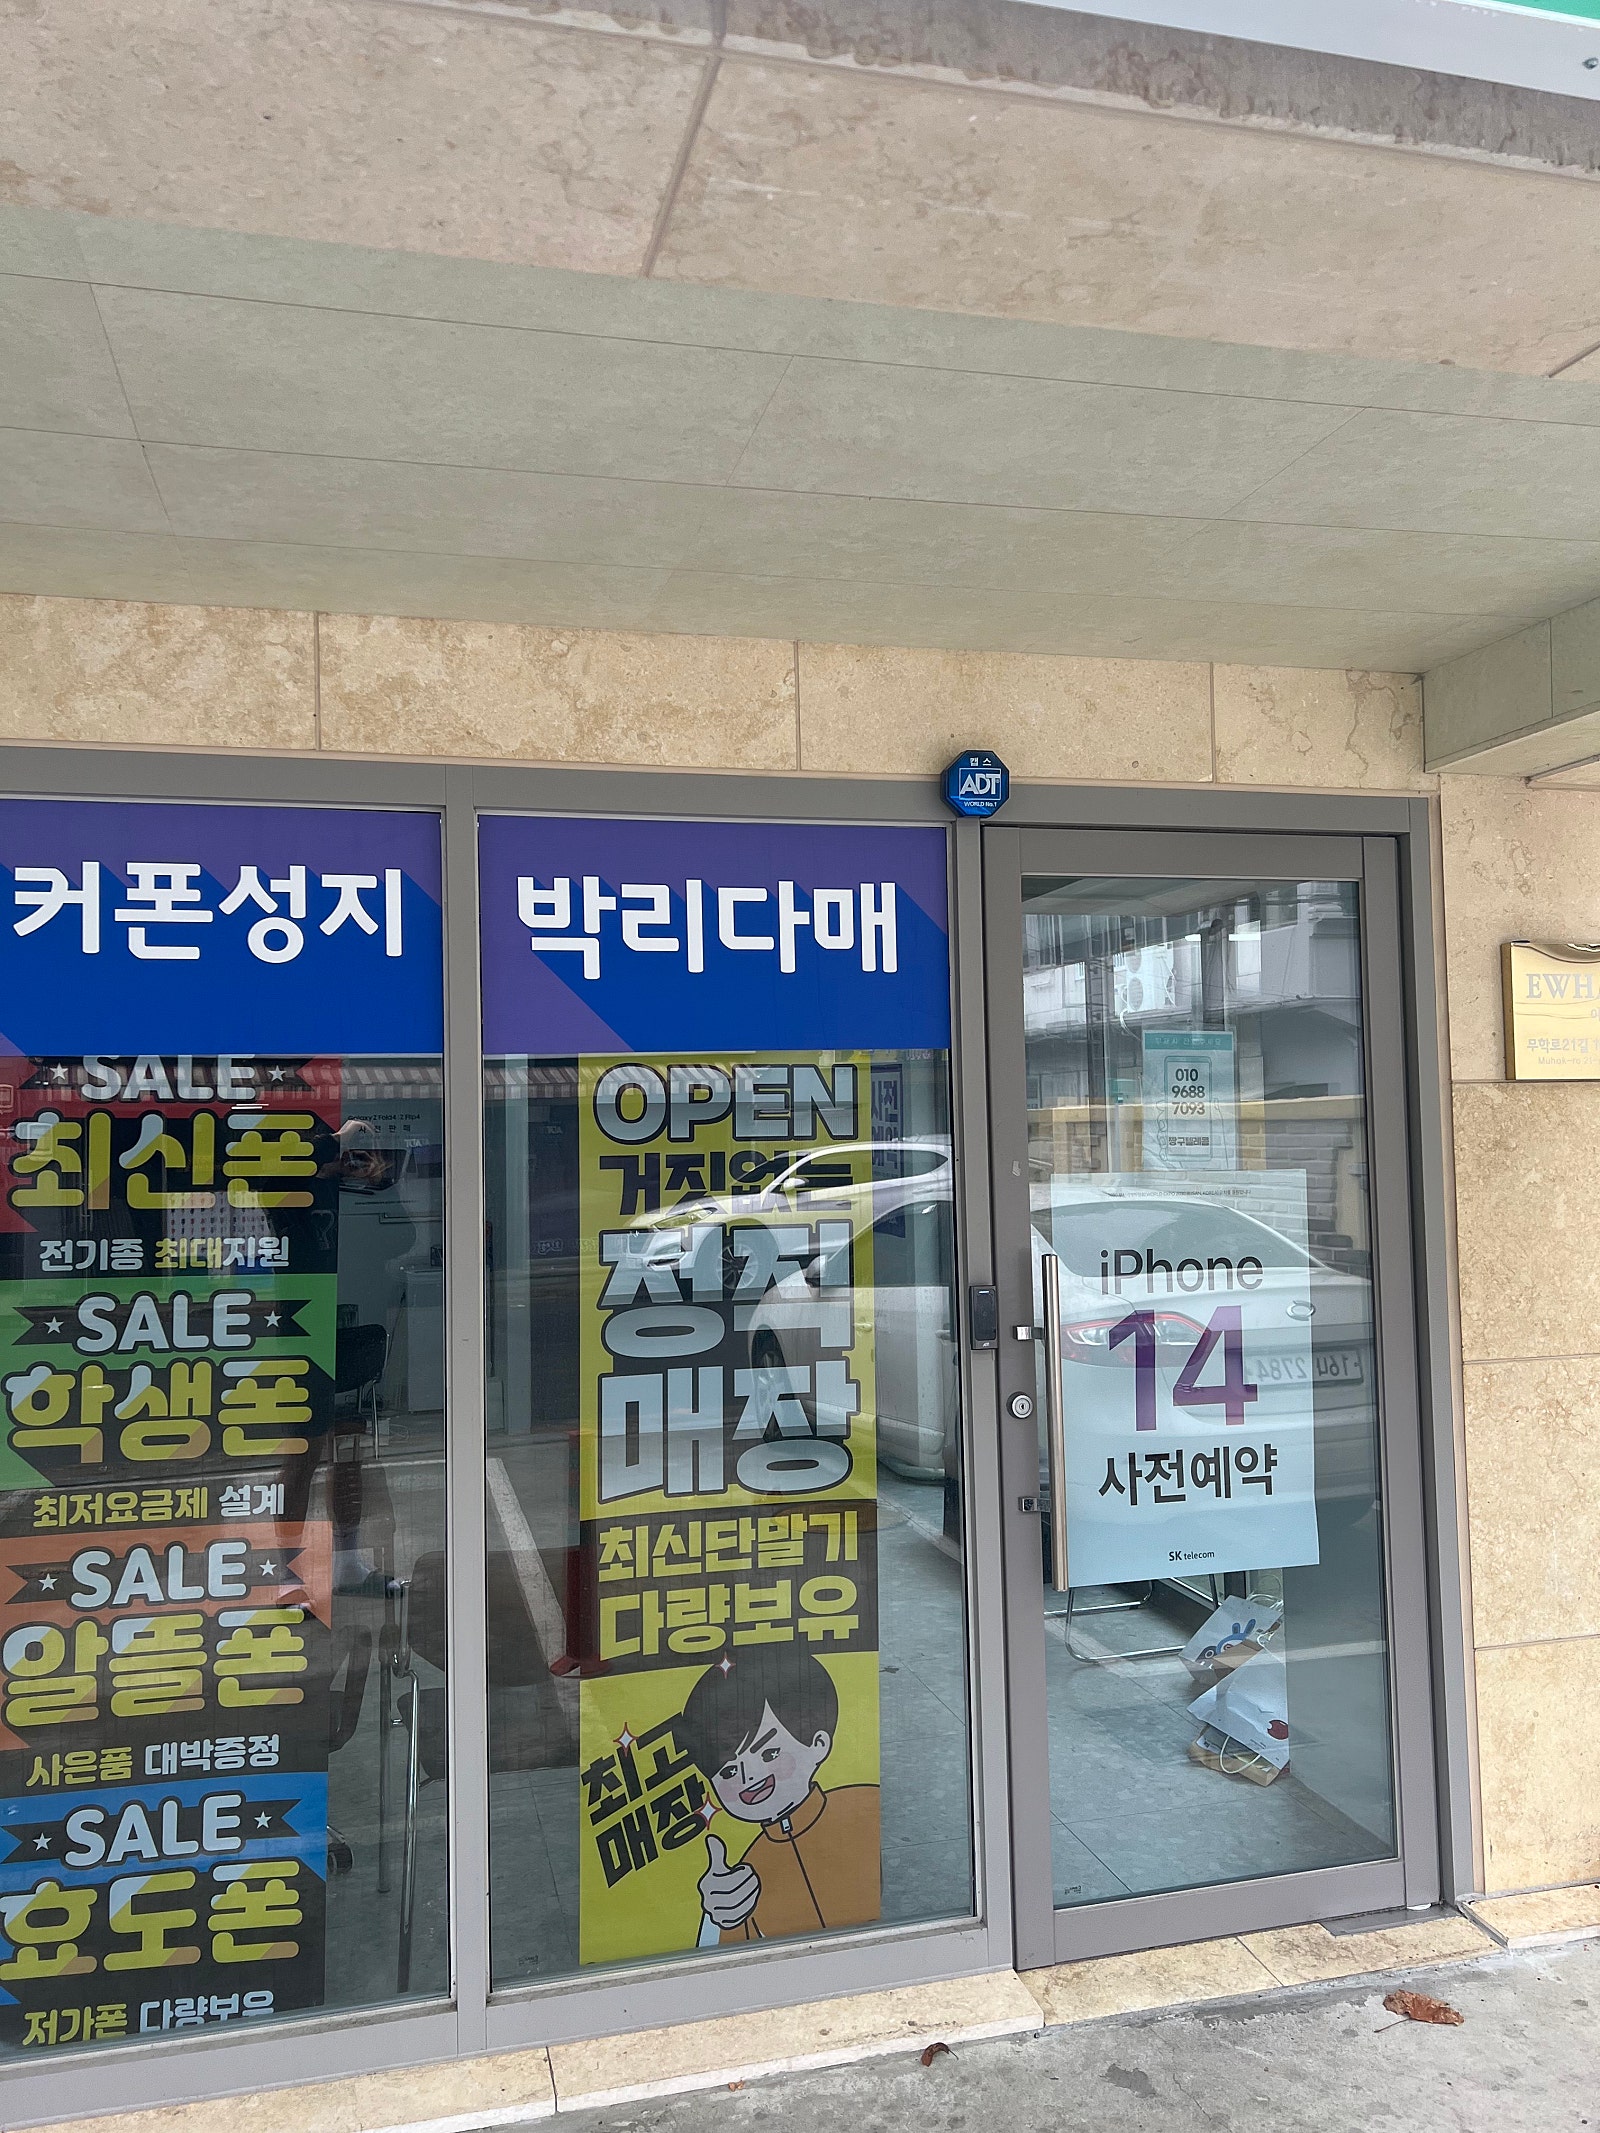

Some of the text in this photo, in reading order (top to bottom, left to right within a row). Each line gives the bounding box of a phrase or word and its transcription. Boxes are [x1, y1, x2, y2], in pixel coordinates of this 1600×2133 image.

[959, 773, 1000, 795] ADT
[13, 861, 403, 964] 커폰성지
[516, 875, 898, 980] 박리다매
[1525, 973, 1600, 999] EWH
[80, 1054, 258, 1101] SALE
[594, 1064, 857, 1144] OPEN
[1171, 1085, 1206, 1099] 9688
[1172, 1101, 1206, 1116] 7093
[1175, 1068, 1199, 1083] 010
[11, 1110, 318, 1210] 최신폰
[598, 1150, 854, 1216] 거짓없는
[39, 1236, 290, 1272] 전기종 최대지원
[1099, 1248, 1264, 1295] iPhone
[75, 1292, 252, 1353] SALE
[600, 1220, 853, 1359] 정직
[1107, 1304, 1259, 1432] 14
[5, 1359, 313, 1464] 학생폰
[600, 1360, 858, 1501] 매장
[32, 1483, 286, 1528] 최저요금제 설계
[1098, 1442, 1279, 1507] 사전예약
[70, 1541, 249, 1608] SALE
[597, 1509, 859, 1583] 최신단말기
[1168, 1549, 1216, 1562] SK telecom
[598, 1574, 860, 1662] 다량보유
[2, 1608, 308, 1727] 알뜰폰
[25, 1733, 281, 1788] 사은품 대박증정
[580, 1712, 697, 1827] 최고
[64, 1793, 243, 1867] SALE
[594, 1772, 709, 1889] 매장
[0, 1860, 304, 1982] 효도폰
[21, 2003, 129, 2047] 저가폰
